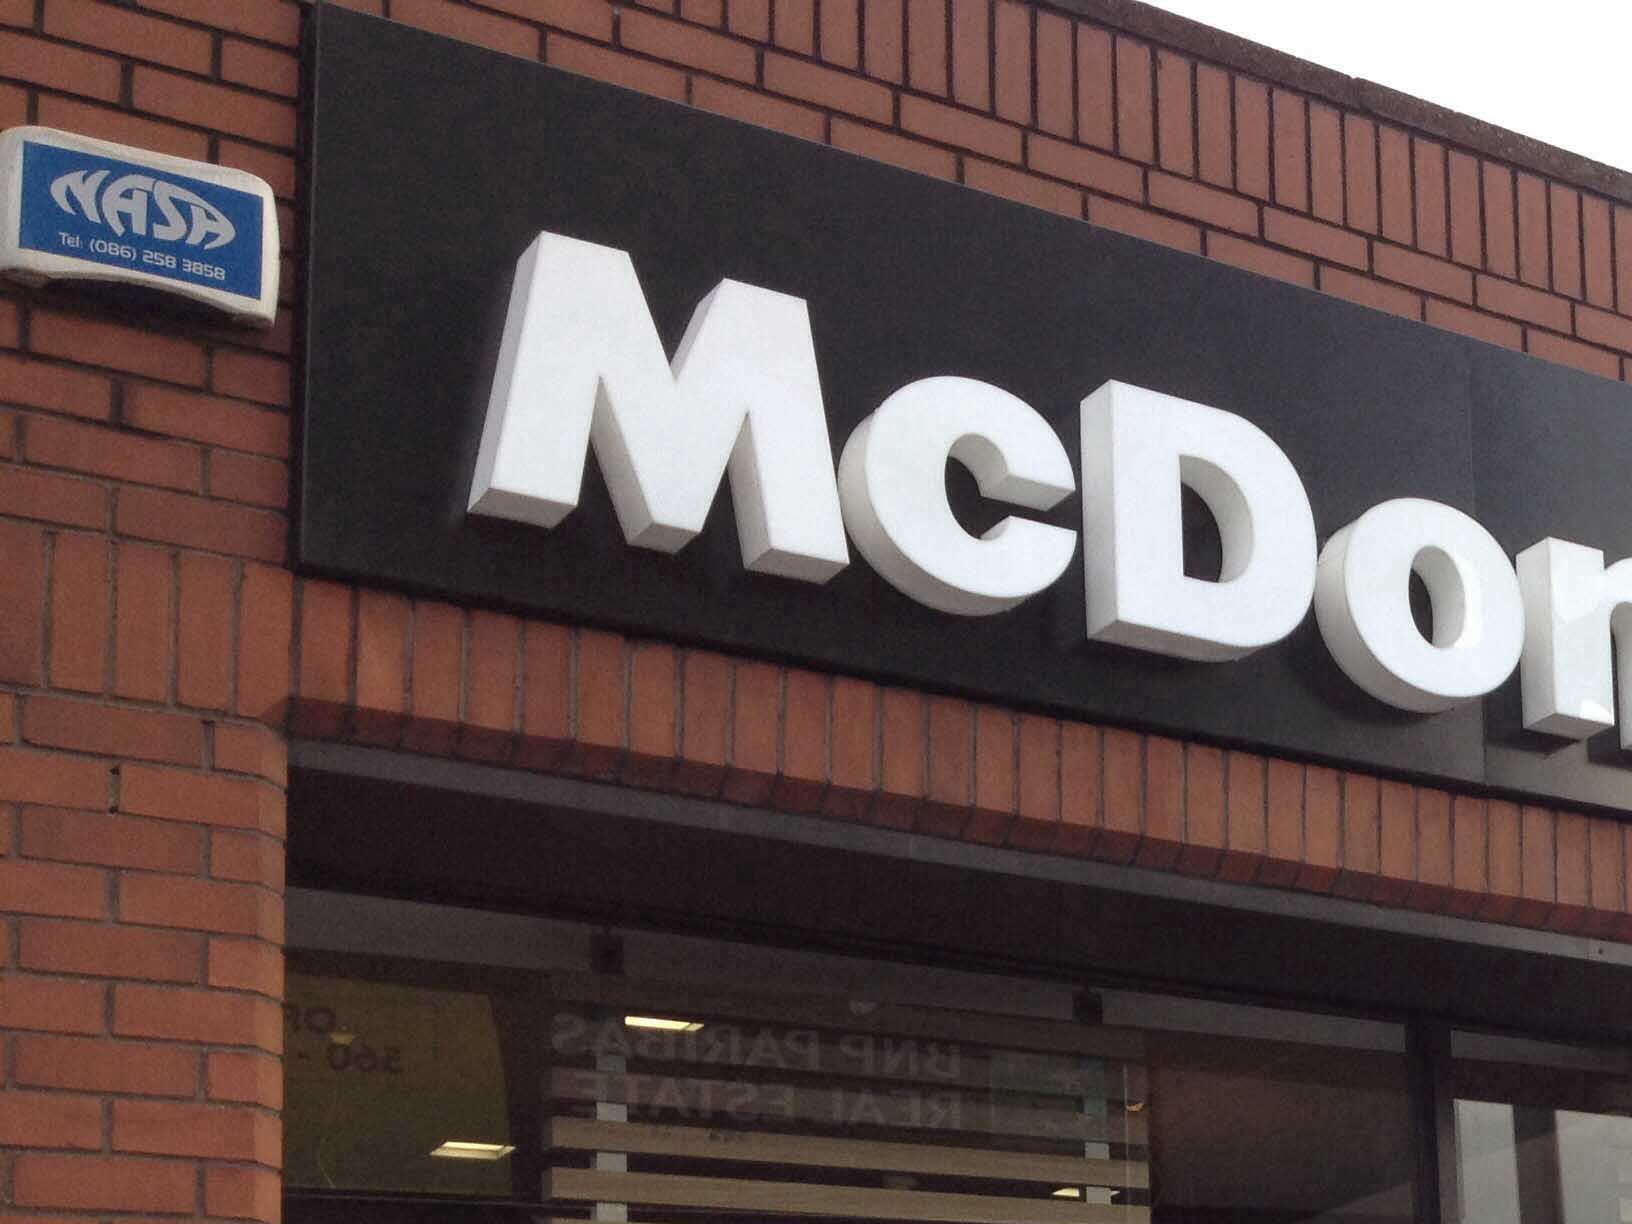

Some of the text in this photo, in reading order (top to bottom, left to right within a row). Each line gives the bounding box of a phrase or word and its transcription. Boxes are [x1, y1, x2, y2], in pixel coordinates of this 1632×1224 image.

[51, 169, 236, 250] NASA
[90, 239, 137, 262] (086)
[143, 250, 177, 269] 258
[182, 258, 226, 281] 3858
